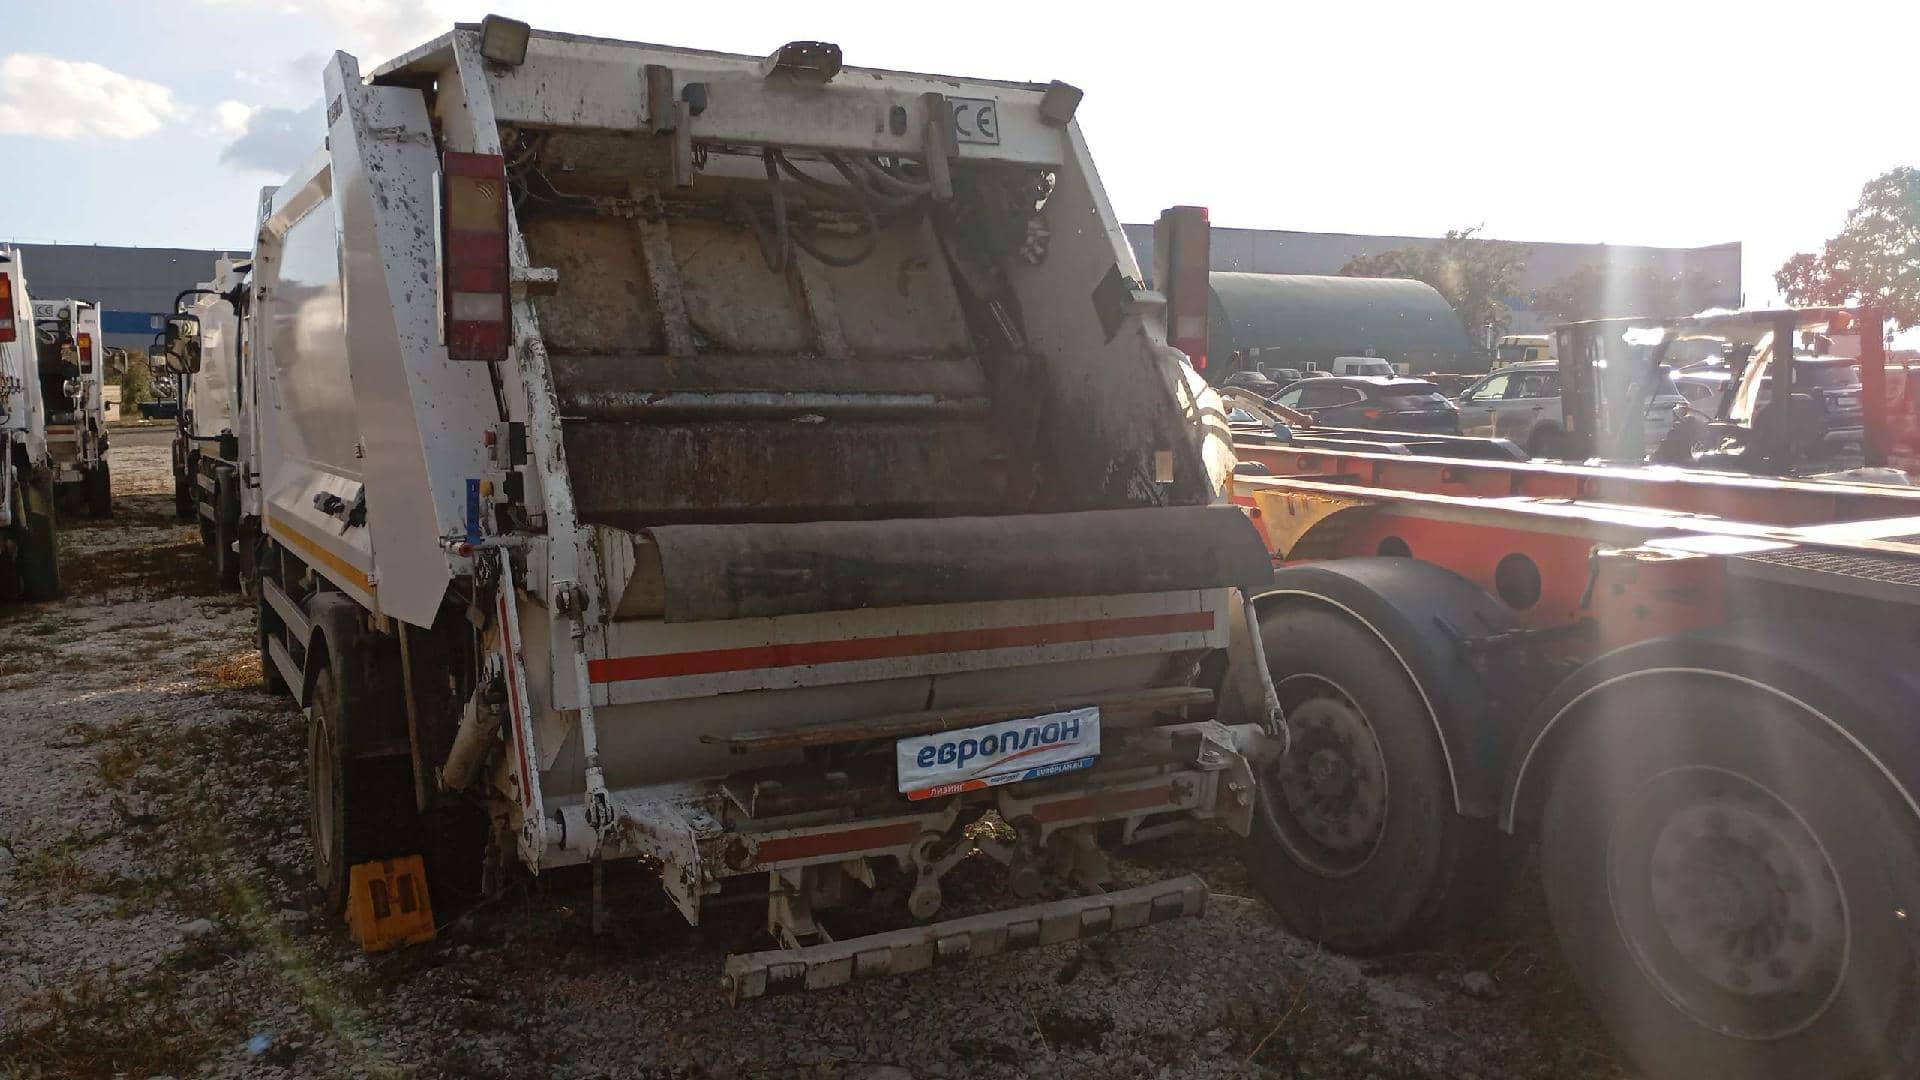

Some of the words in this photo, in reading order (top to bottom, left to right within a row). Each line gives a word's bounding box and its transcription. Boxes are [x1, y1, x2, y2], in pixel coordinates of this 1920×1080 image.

[953, 104, 994, 138] CE
[917, 718, 1079, 768] европлан
[930, 783, 965, 796] ЛИЗИНГ
